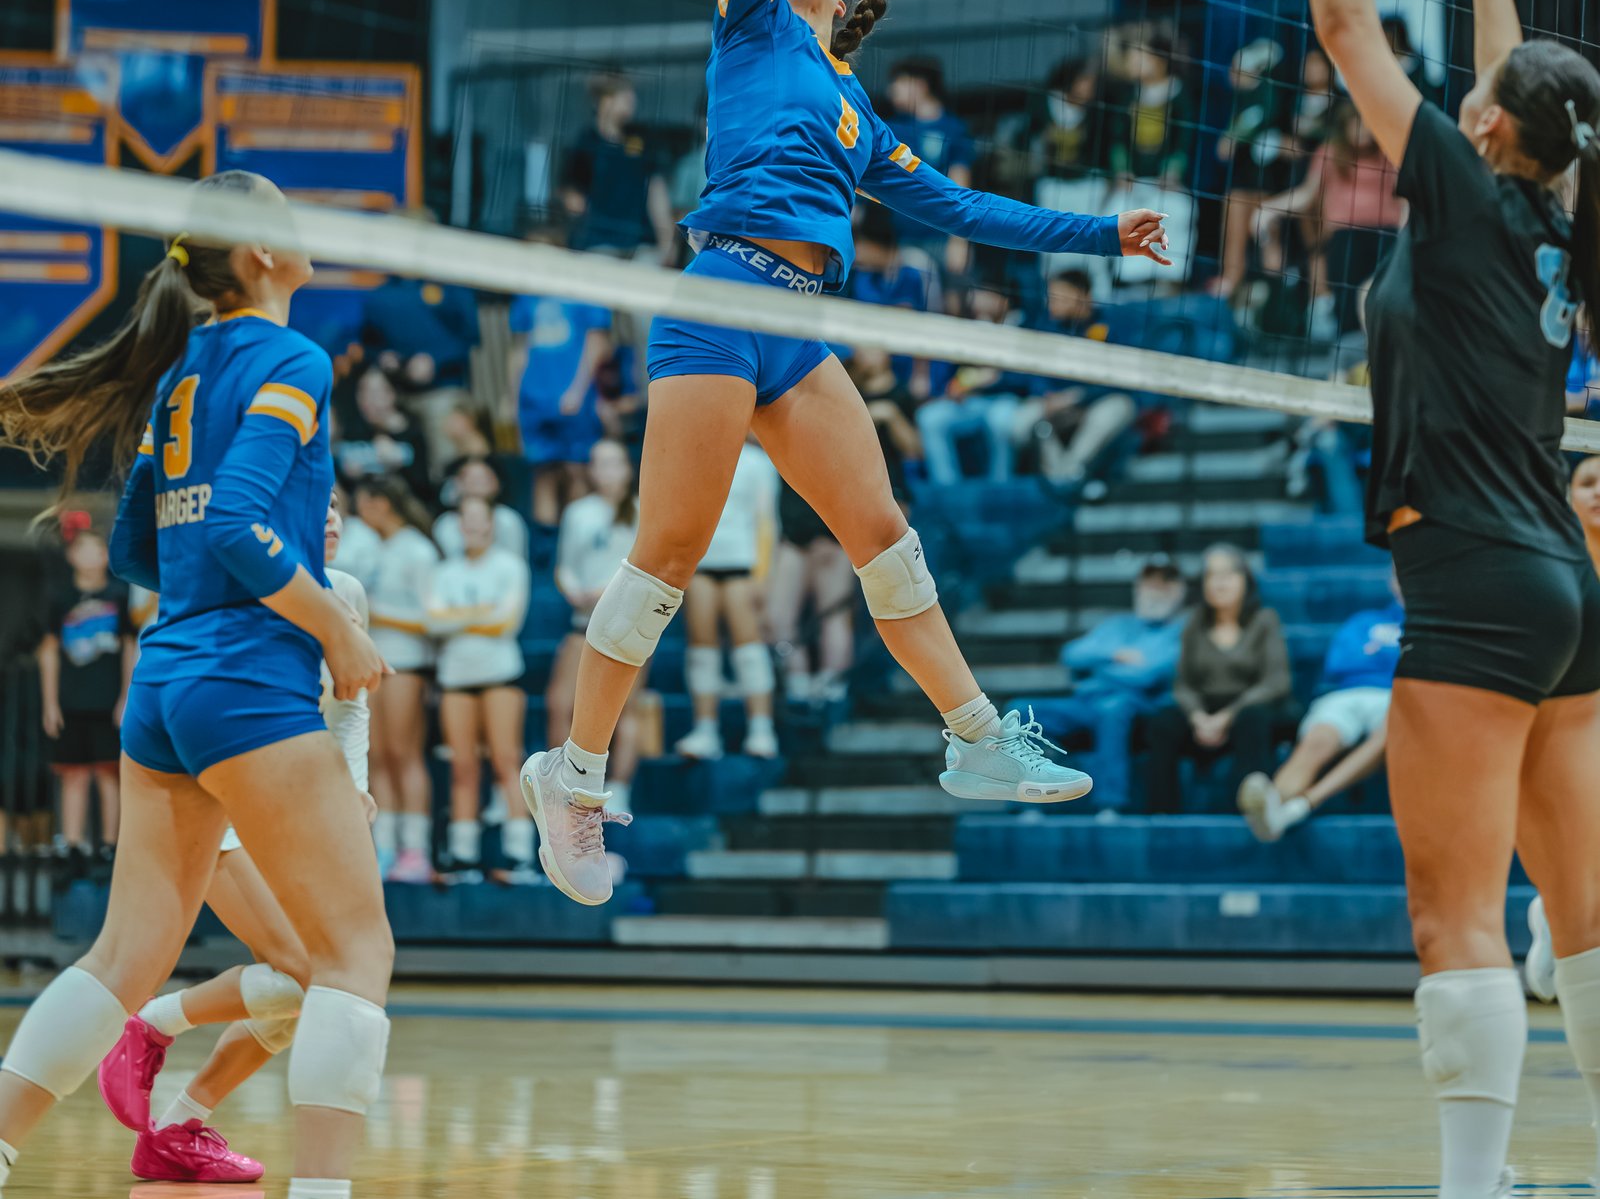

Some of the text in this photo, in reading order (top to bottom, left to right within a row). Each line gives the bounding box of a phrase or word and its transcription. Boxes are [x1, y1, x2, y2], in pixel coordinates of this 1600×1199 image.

[709, 236, 775, 272] NIKE
[771, 264, 818, 297] PRO
[163, 373, 201, 481] 3
